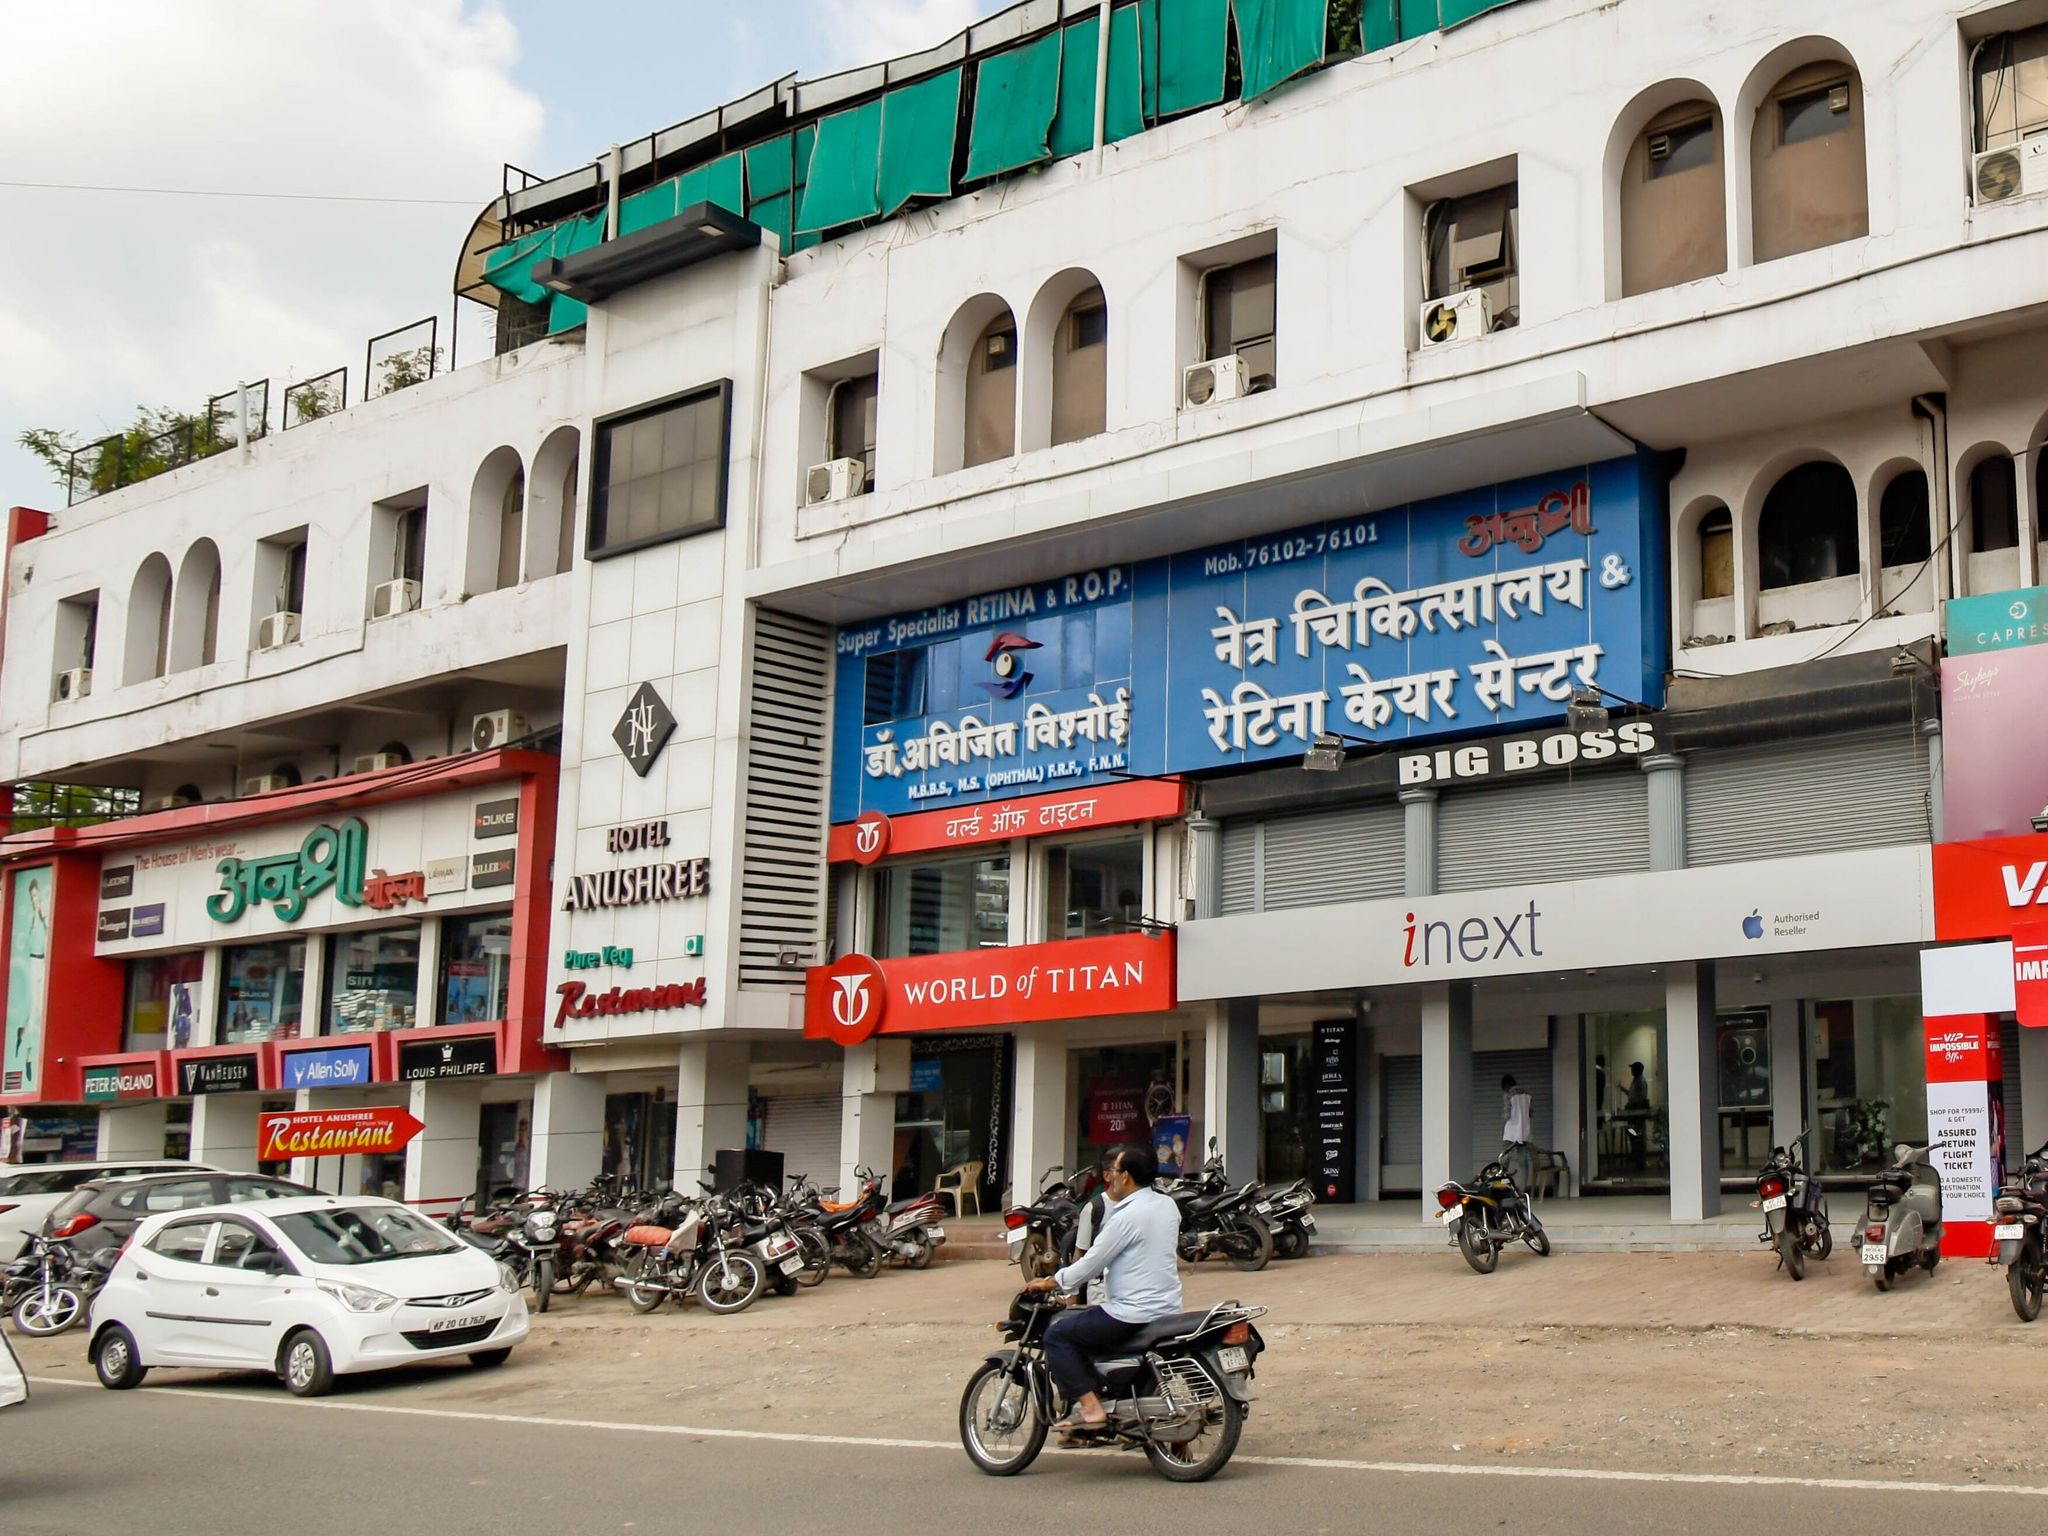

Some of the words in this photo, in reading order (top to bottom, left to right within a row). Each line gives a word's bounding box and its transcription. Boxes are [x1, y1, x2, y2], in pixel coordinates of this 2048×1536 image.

[1205, 552, 1242, 576] Mob.
[1247, 522, 1378, 567] 76102-76101
[836, 628, 881, 655] Super
[888, 608, 961, 645] Specialist
[966, 586, 1036, 626] RETINA
[1046, 589, 1057, 608] &
[1065, 568, 1128, 605] R.O.P.
[1210, 606, 1281, 669] नेत्र
[1289, 558, 1590, 658] चिकित्सालय
[1600, 553, 1632, 589] &
[1200, 681, 1330, 753] रेटिना
[1339, 663, 1460, 730] केयर
[1468, 640, 1605, 712] सेन्टर
[1024, 687, 1134, 752] विश्नोई
[1399, 745, 1490, 786] BIG
[1503, 721, 1656, 772] BOSS
[958, 775, 980, 792] M.S.
[985, 766, 1044, 789] (OPHTHAL)
[482, 812, 515, 826] DUKE
[946, 808, 983, 839] वर्ल्ड
[1040, 799, 1098, 828] टाइटन
[606, 820, 672, 853] HOTEL
[135, 855, 150, 871] The
[151, 851, 178, 868] House
[179, 845, 190, 863] of
[206, 816, 370, 923] अनुश्री
[560, 856, 711, 912] ANUSHREE
[1773, 910, 1820, 925] Authorised
[1774, 924, 1807, 937] Reseller
[1402, 899, 1543, 968] inext
[564, 949, 600, 969] Pure
[601, 945, 634, 969] Veg
[904, 975, 1007, 1005] WORLD
[1016, 965, 1039, 1000] of
[1046, 960, 1144, 995] TITAN
[553, 976, 707, 1029] Restaurant
[1929, 1041, 1979, 1053] IMPOSSIBLE
[1944, 1032, 1964, 1042] VIP
[306, 1060, 332, 1080] Allen
[333, 1059, 360, 1081] Solly
[406, 1066, 436, 1079] LOUIS
[439, 1062, 486, 1077] PHILIPPE
[84, 1076, 110, 1094] PETER
[110, 1073, 154, 1092] ENGLAND
[293, 1115, 323, 1124] HOTEL
[325, 1112, 374, 1122] ANUSHREE
[264, 1117, 394, 1158] Restaurant
[1937, 1128, 1977, 1138] ASSURED
[1941, 1140, 1976, 1148] RETURN
[1943, 1150, 1973, 1159] FLIGHT
[1944, 1161, 1974, 1170] TICKET
